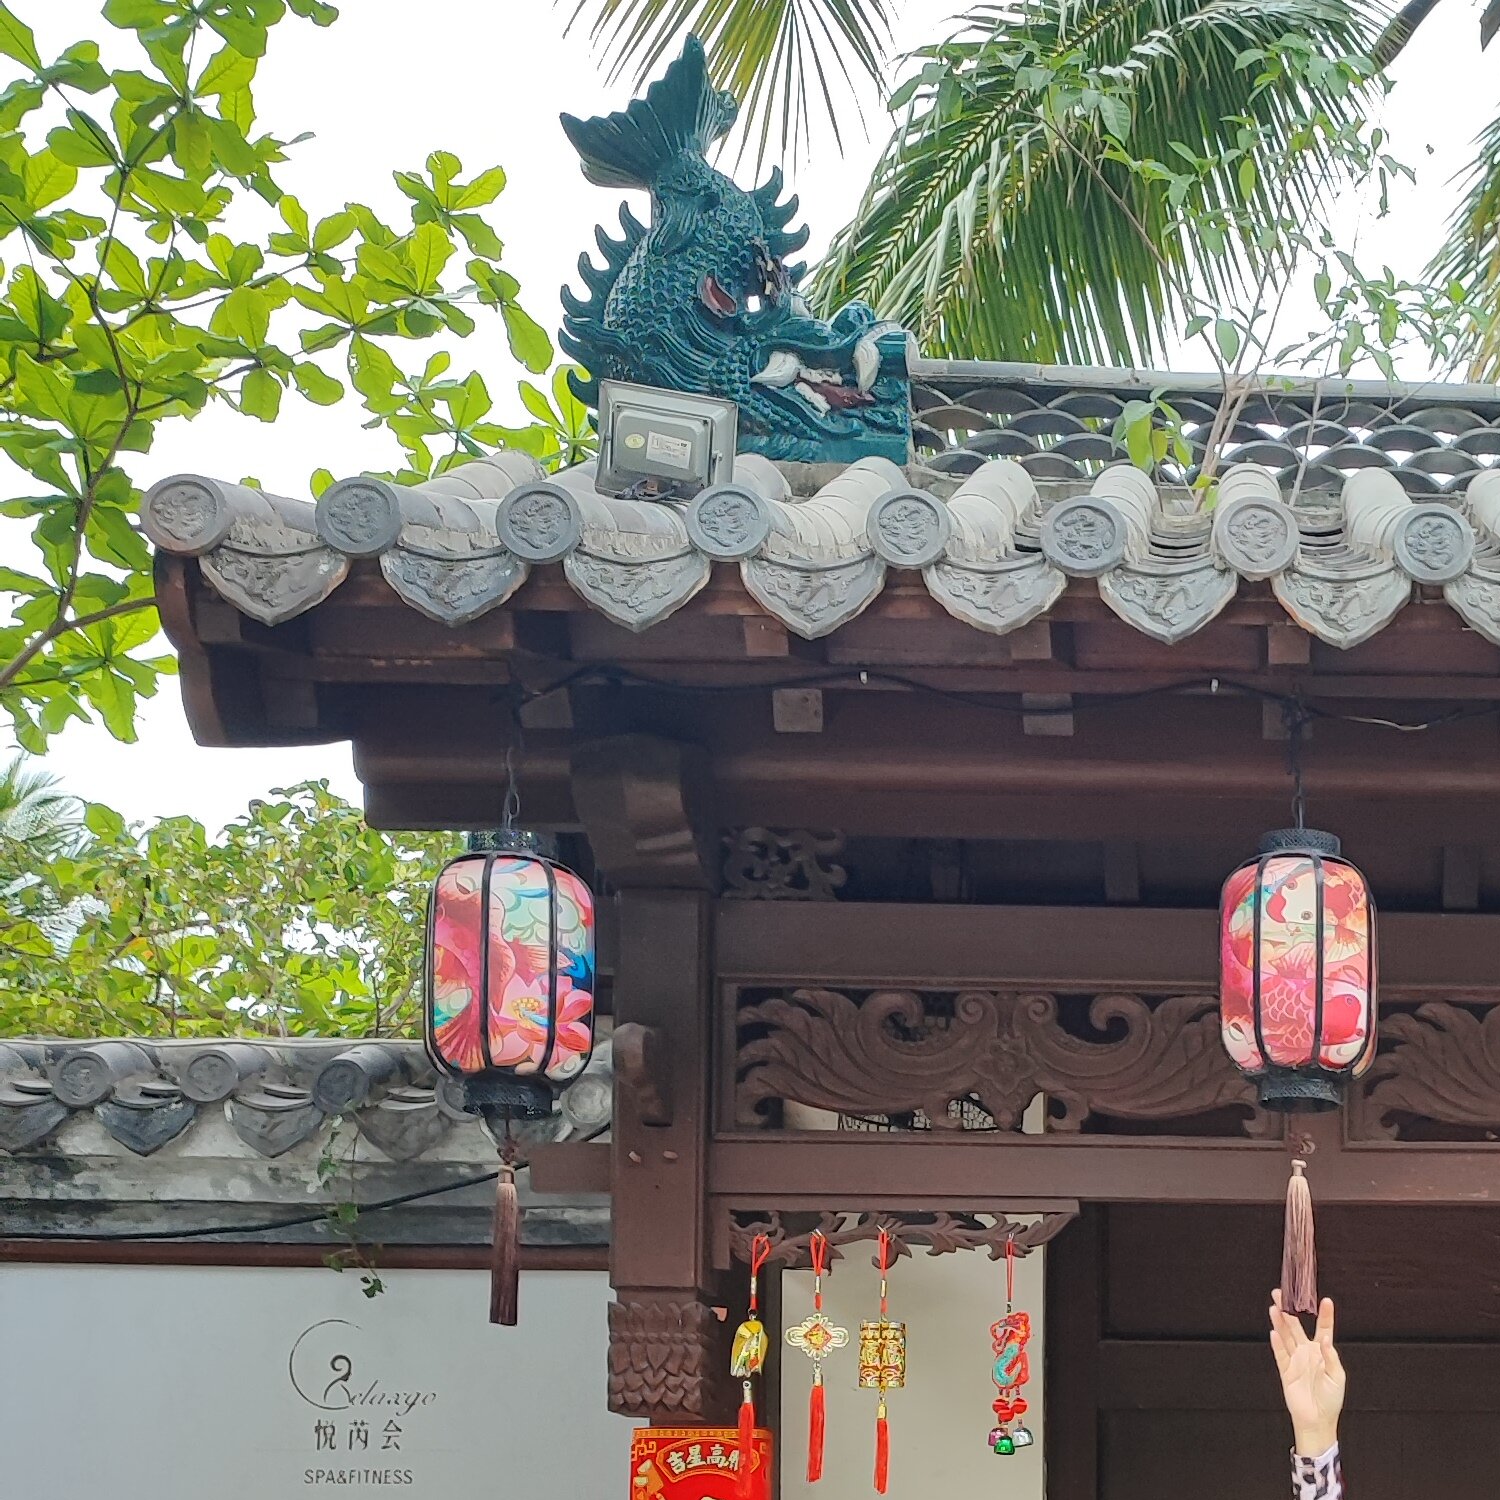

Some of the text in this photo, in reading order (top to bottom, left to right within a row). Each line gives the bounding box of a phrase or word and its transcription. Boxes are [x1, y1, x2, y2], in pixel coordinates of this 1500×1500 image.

[314, 1418, 402, 1451] 悦芮会
[303, 1468, 413, 1485] SPA&FITNESS
